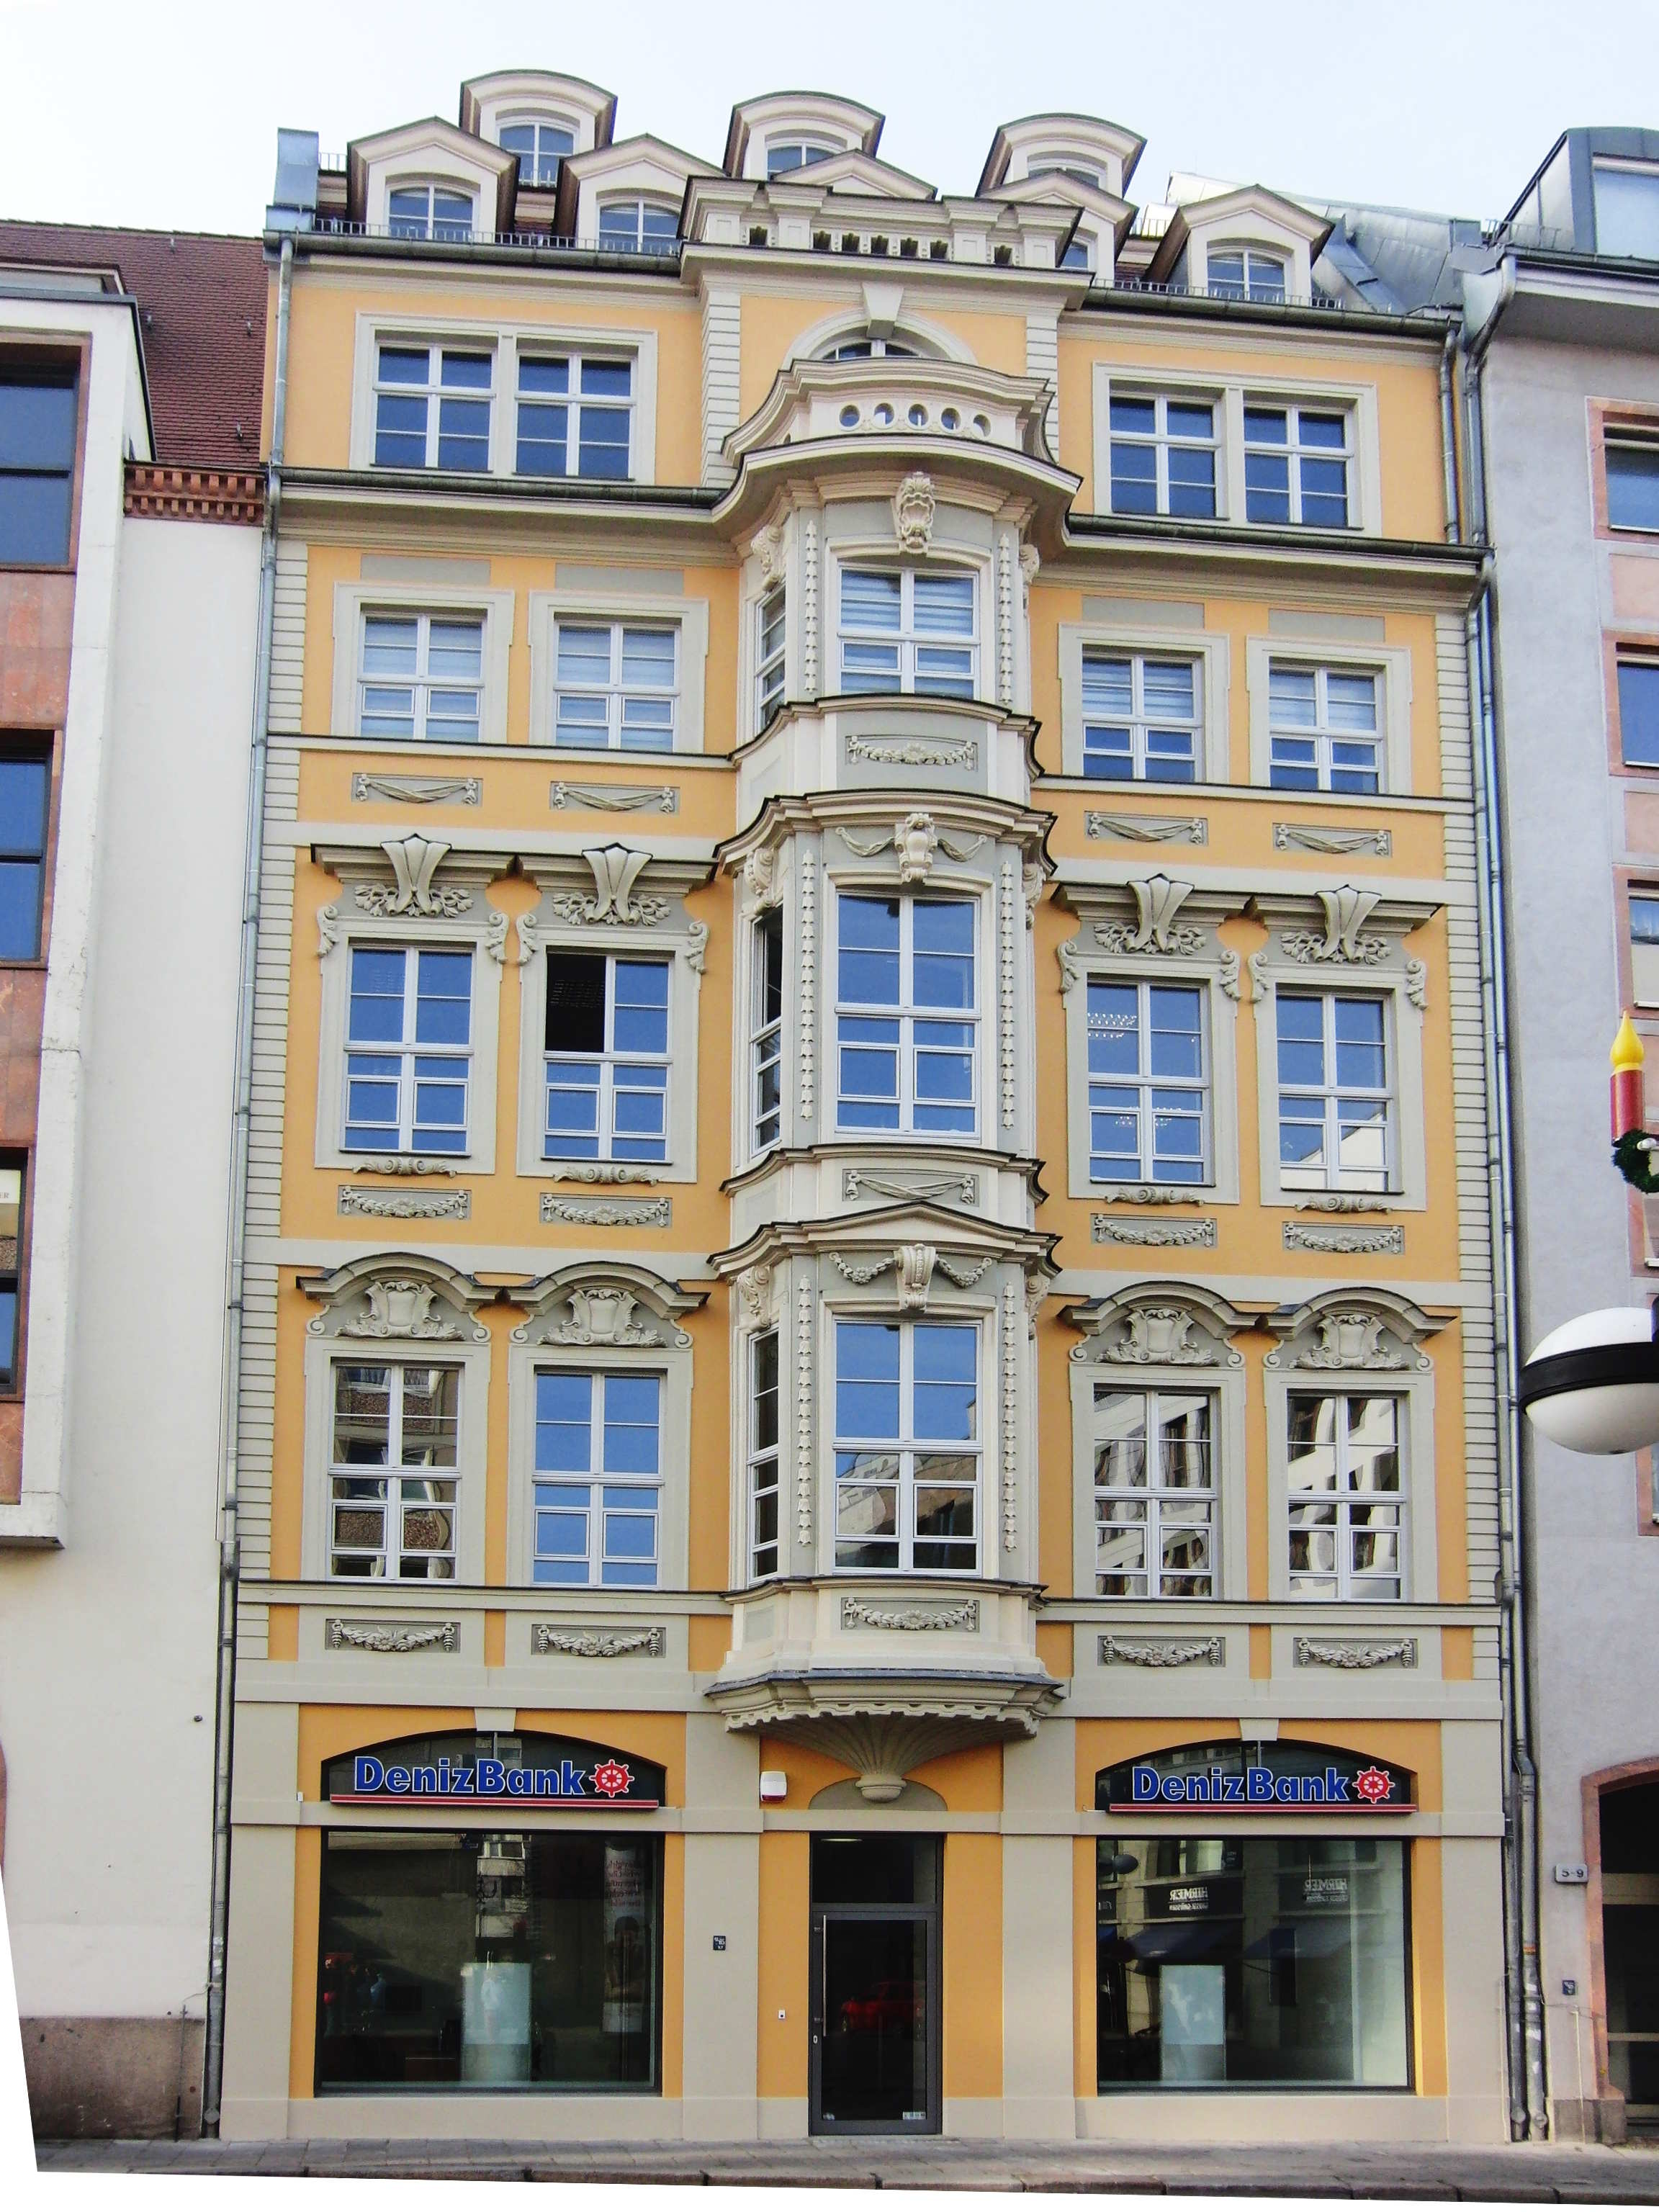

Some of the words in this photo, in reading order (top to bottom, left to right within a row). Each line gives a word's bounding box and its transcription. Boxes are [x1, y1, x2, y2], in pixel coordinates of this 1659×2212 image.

[355, 1756, 585, 1795] DenizBank
[1132, 1766, 1349, 1802] DenizBank
[1561, 1869, 1584, 1878] 5-9
